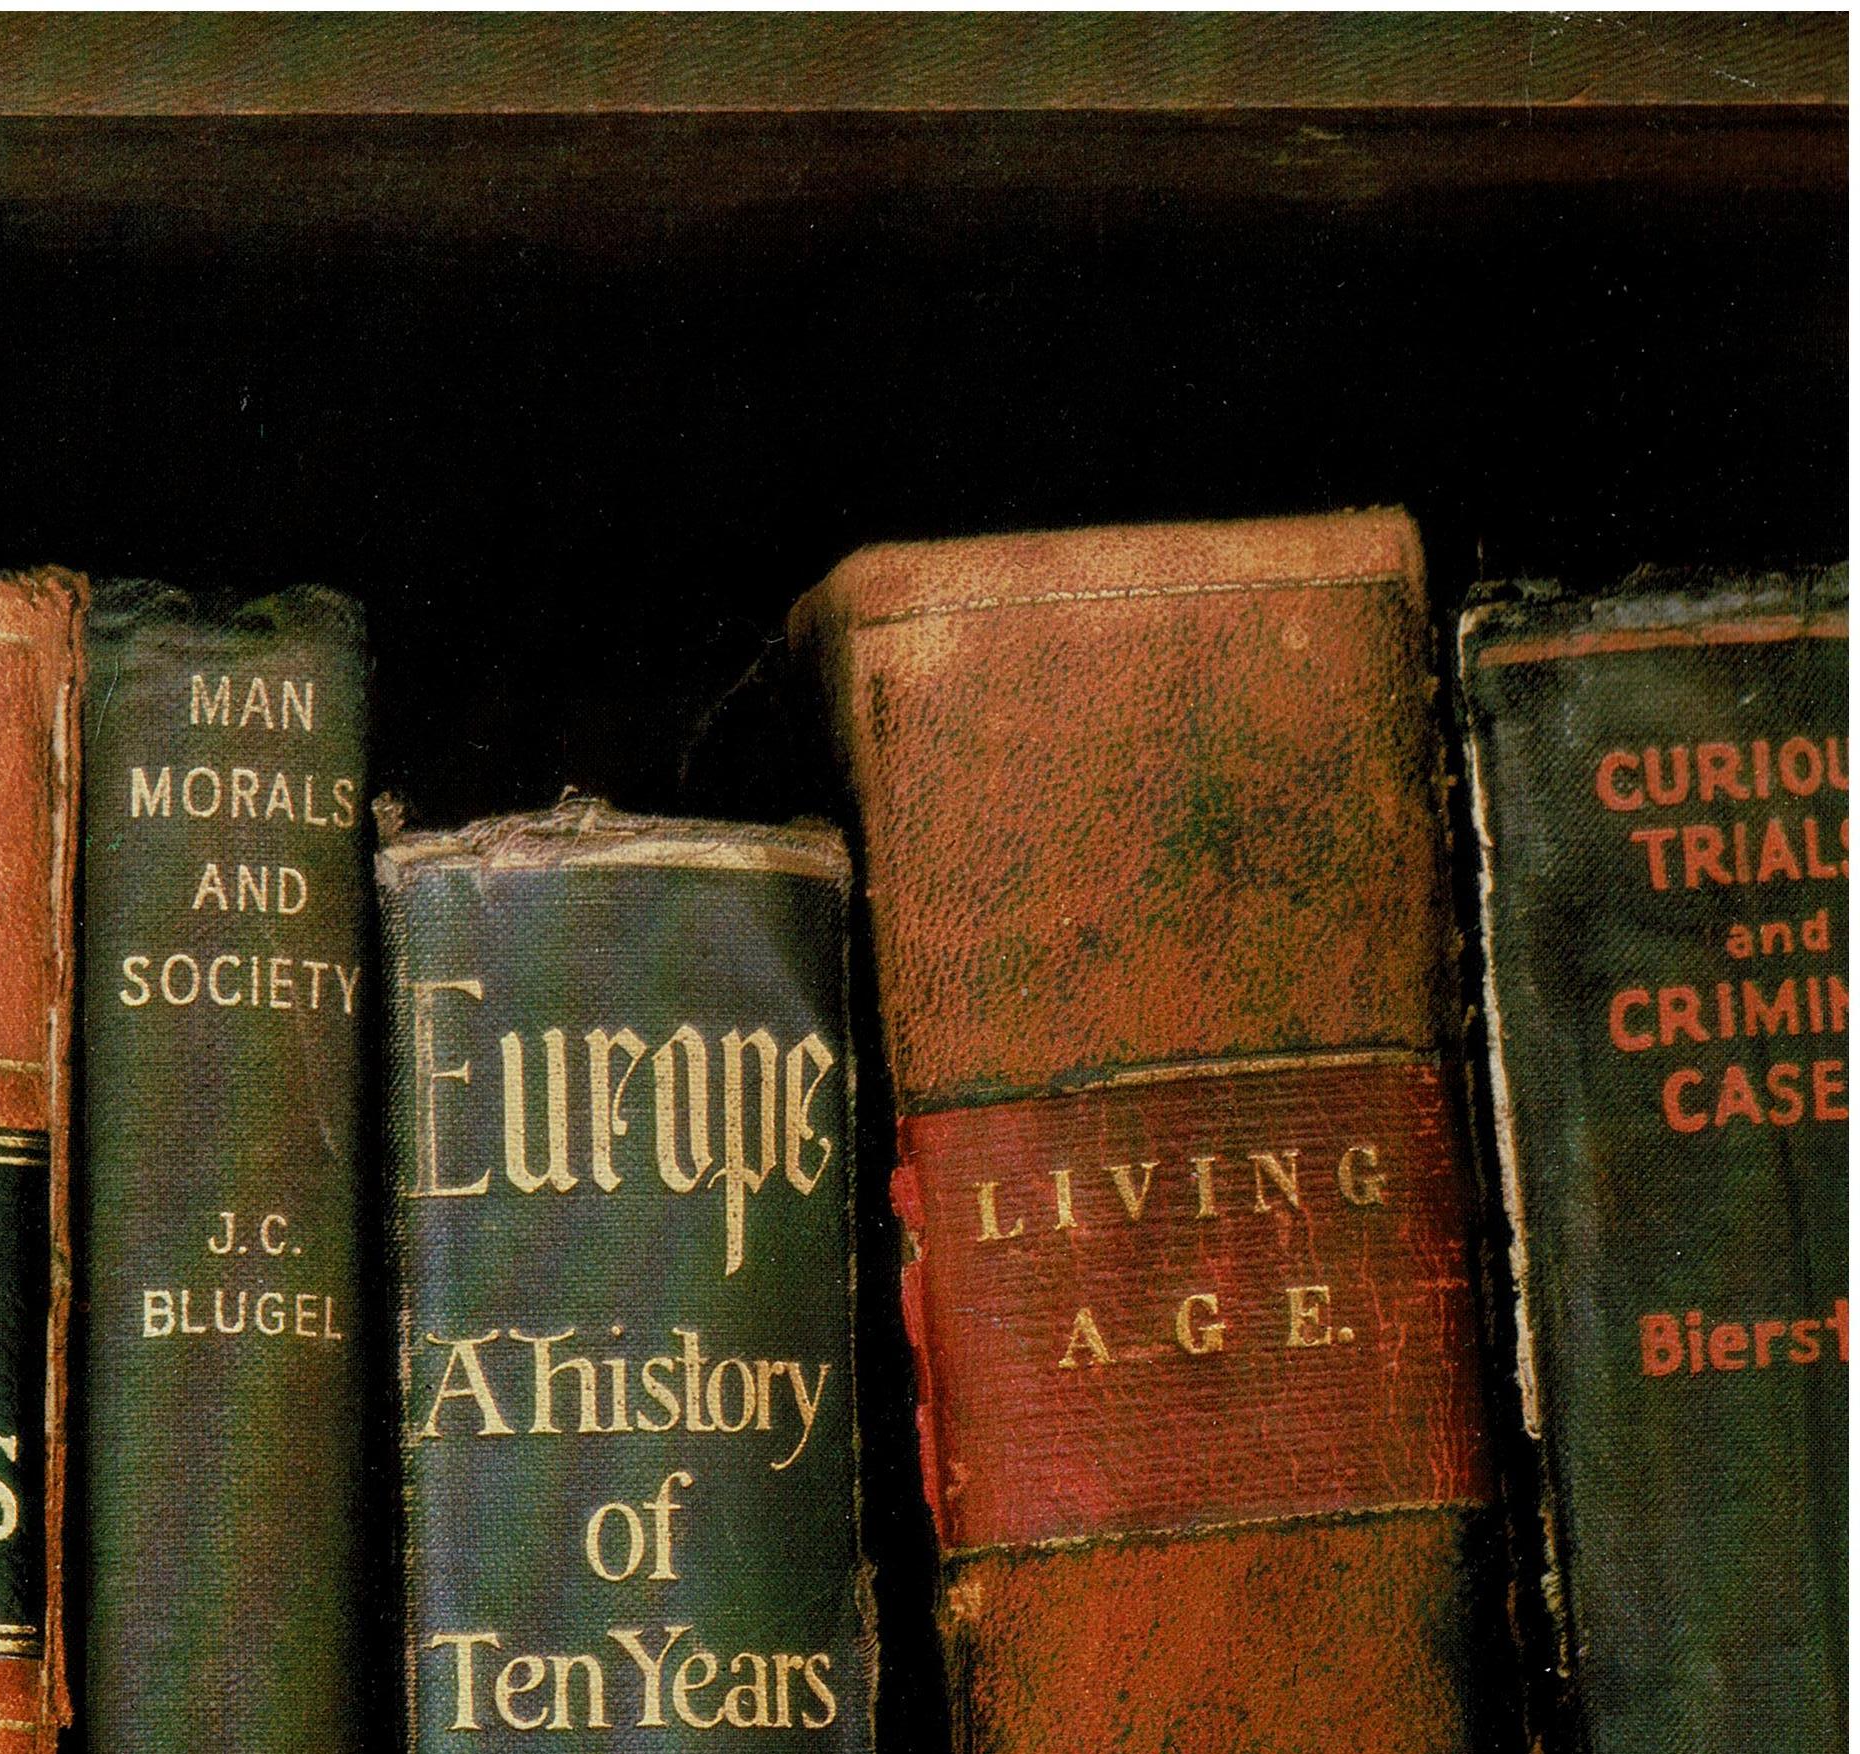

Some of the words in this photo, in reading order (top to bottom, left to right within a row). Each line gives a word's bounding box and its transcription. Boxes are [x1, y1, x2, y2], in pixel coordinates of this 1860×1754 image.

[190, 675, 314, 732] MAN
[131, 766, 357, 829] MORALS
[192, 863, 308, 915] AND
[1630, 818, 1849, 890] TRIAL
[1726, 908, 1829, 959] and
[119, 954, 361, 1015] SOCIETY
[406, 979, 834, 1276] Europe
[1662, 1059, 1849, 1133] CASE
[974, 1144, 1387, 1242] LIVING
[208, 1212, 301, 1255] J.C.
[143, 1290, 344, 1340] BLUGEL
[1638, 1297, 1849, 1377] Bierst
[412, 1328, 516, 1441] A
[509, 1325, 831, 1470] history
[587, 1471, 693, 1582] of
[423, 1632, 613, 1731] Ten
[607, 1625, 837, 1731] Years
